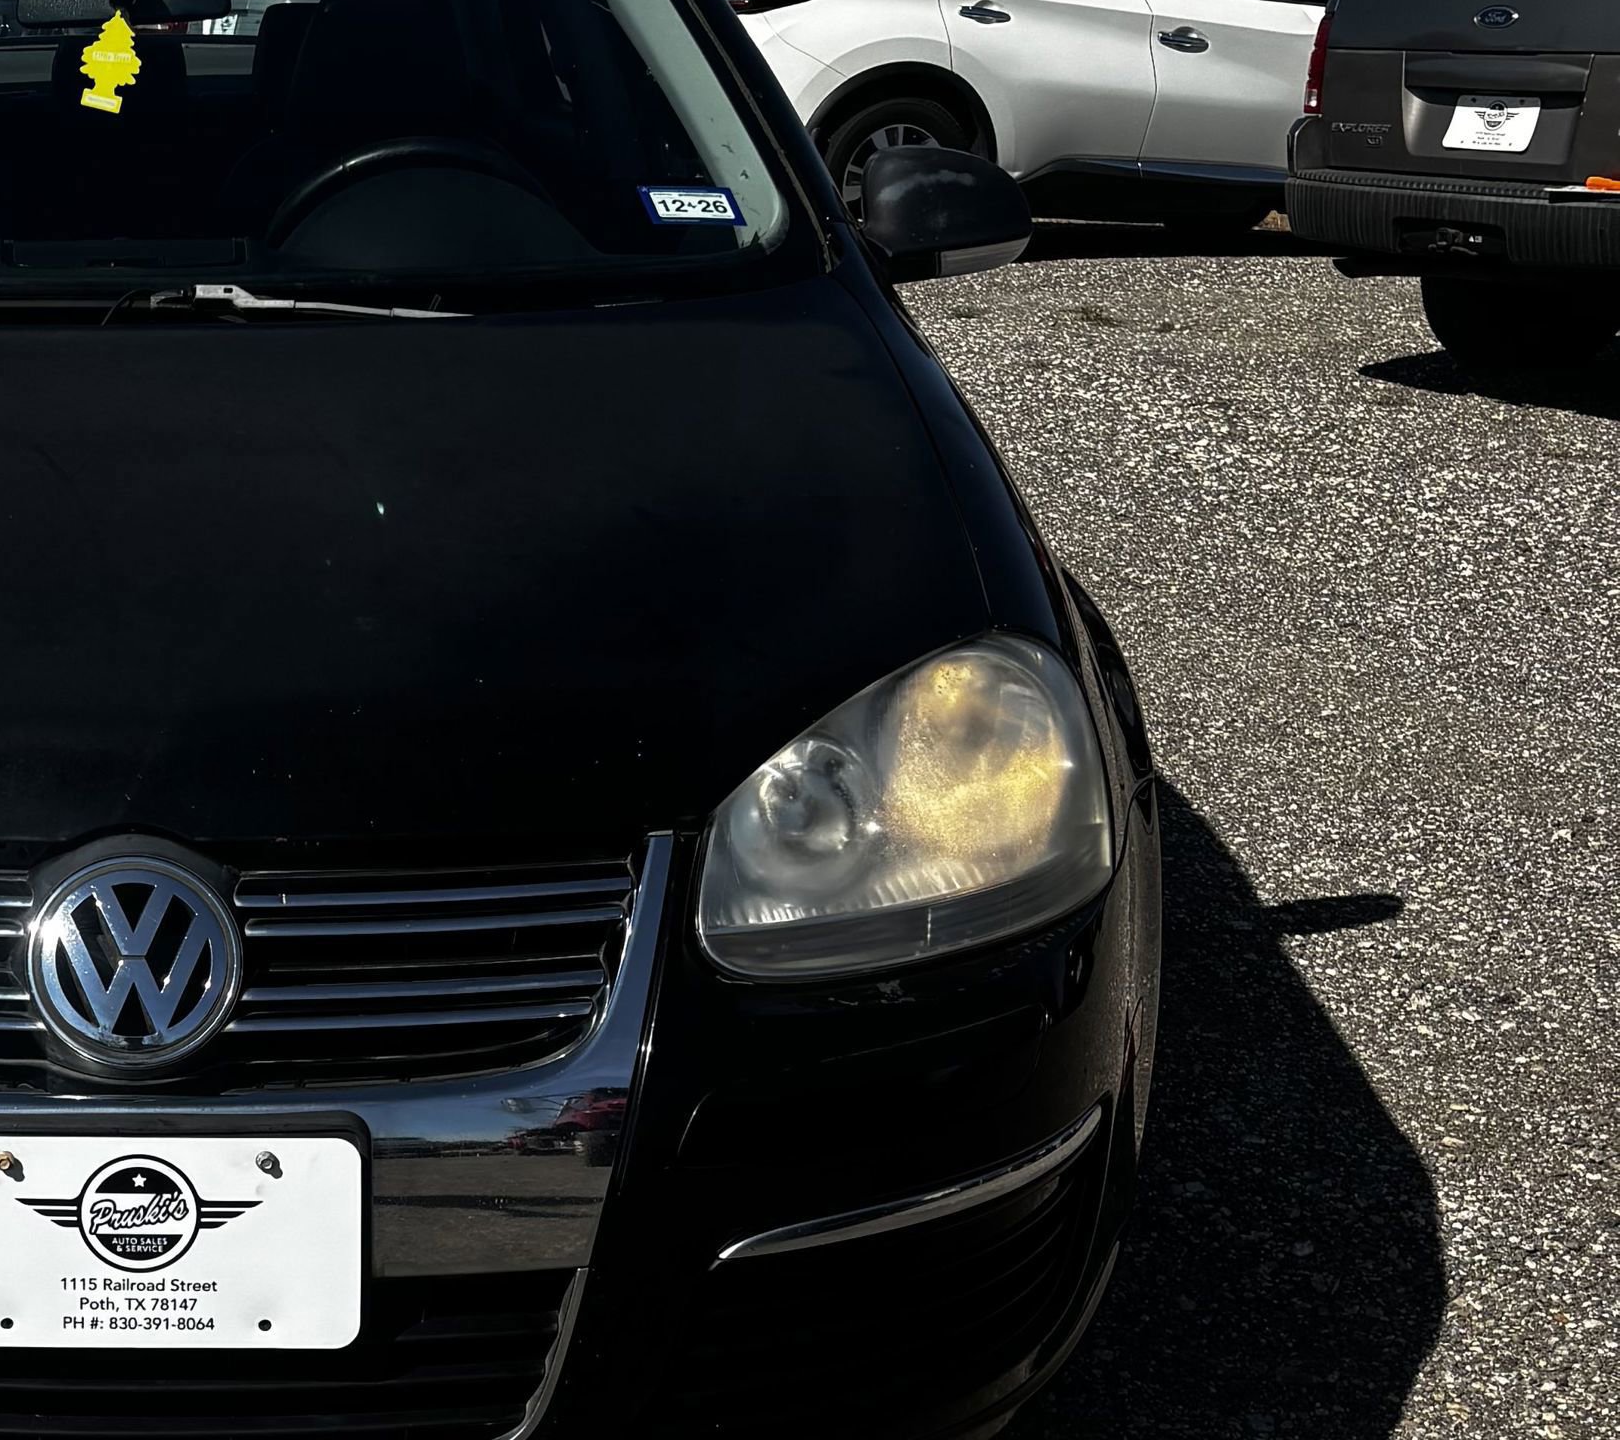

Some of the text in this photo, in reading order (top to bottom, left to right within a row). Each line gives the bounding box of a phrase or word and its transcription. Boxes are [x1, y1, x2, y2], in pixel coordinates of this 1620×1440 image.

[89, 1191, 189, 1235] Pruski's
[112, 1237, 168, 1246] AUTO SALES
[125, 1245, 164, 1253] SERVICE
[61, 1277, 218, 1292] 1115 Railroad Street
[79, 1297, 198, 1312] Poth, TX 78147
[63, 1316, 215, 1330] PH #: 830-391-8064
